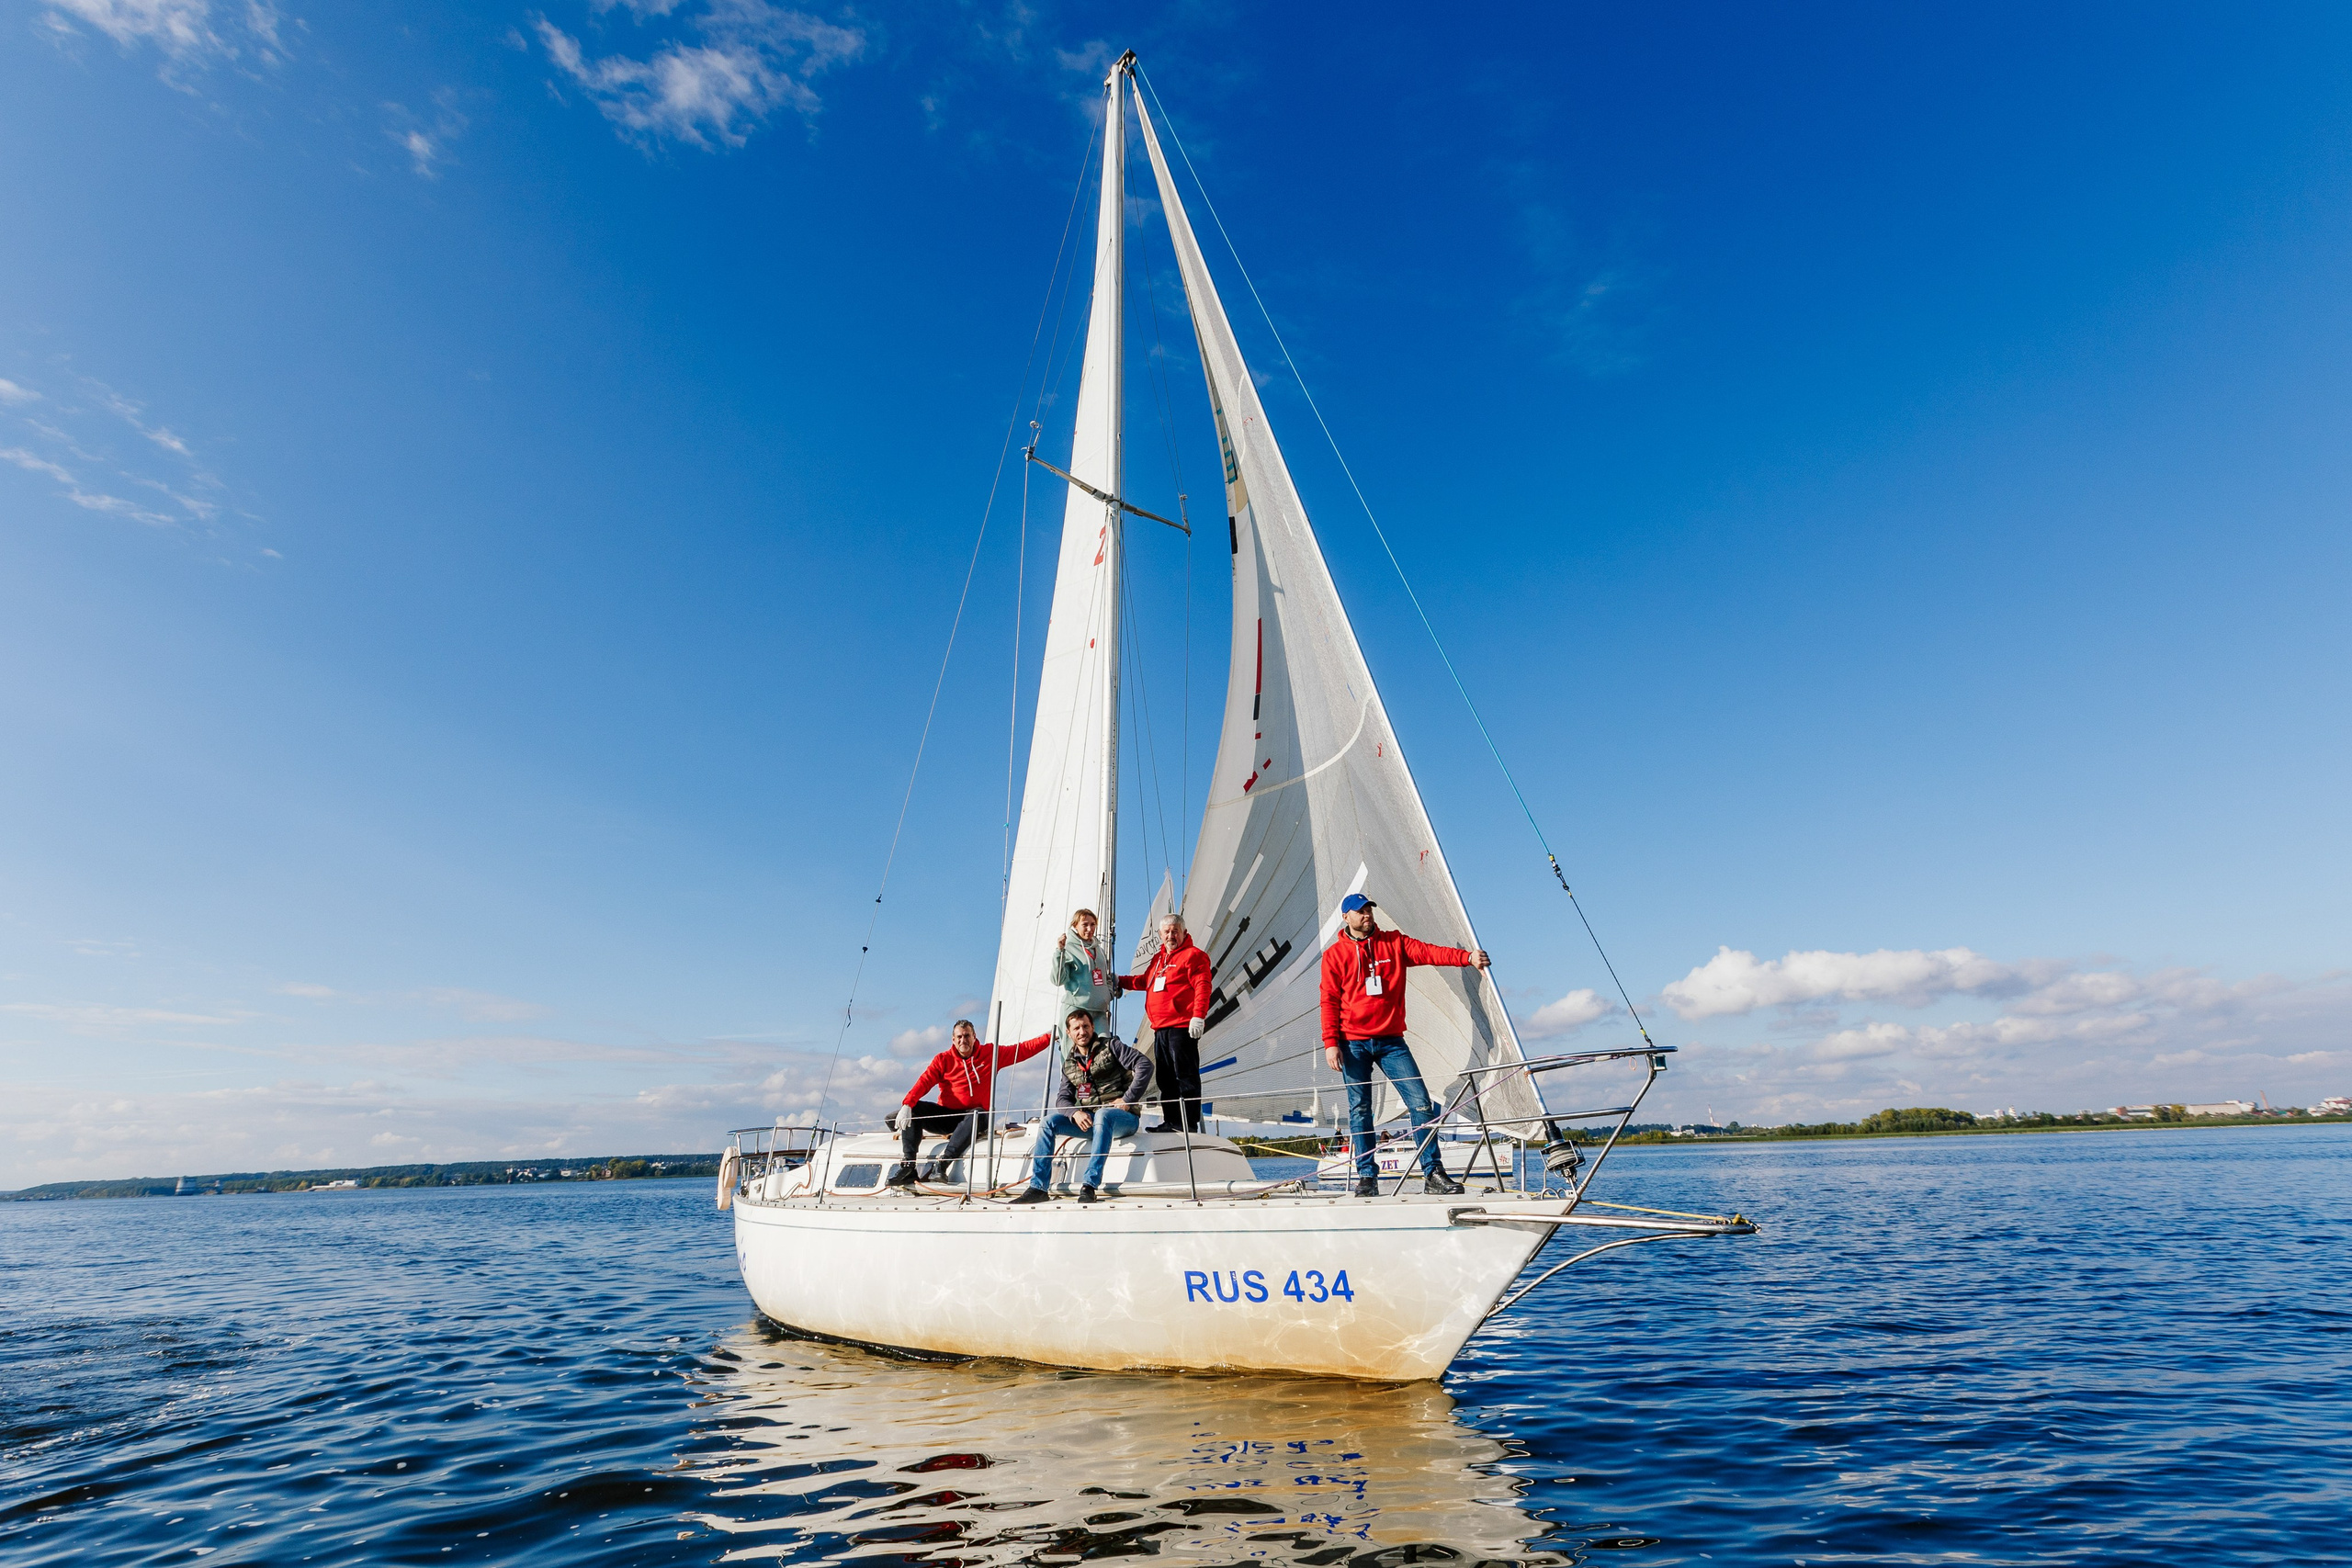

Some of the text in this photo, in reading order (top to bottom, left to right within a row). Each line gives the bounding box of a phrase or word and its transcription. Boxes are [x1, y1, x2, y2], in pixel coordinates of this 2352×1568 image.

[1381, 1159, 1399, 1170] ZET
[1183, 1269, 1355, 1303] RUS 434
